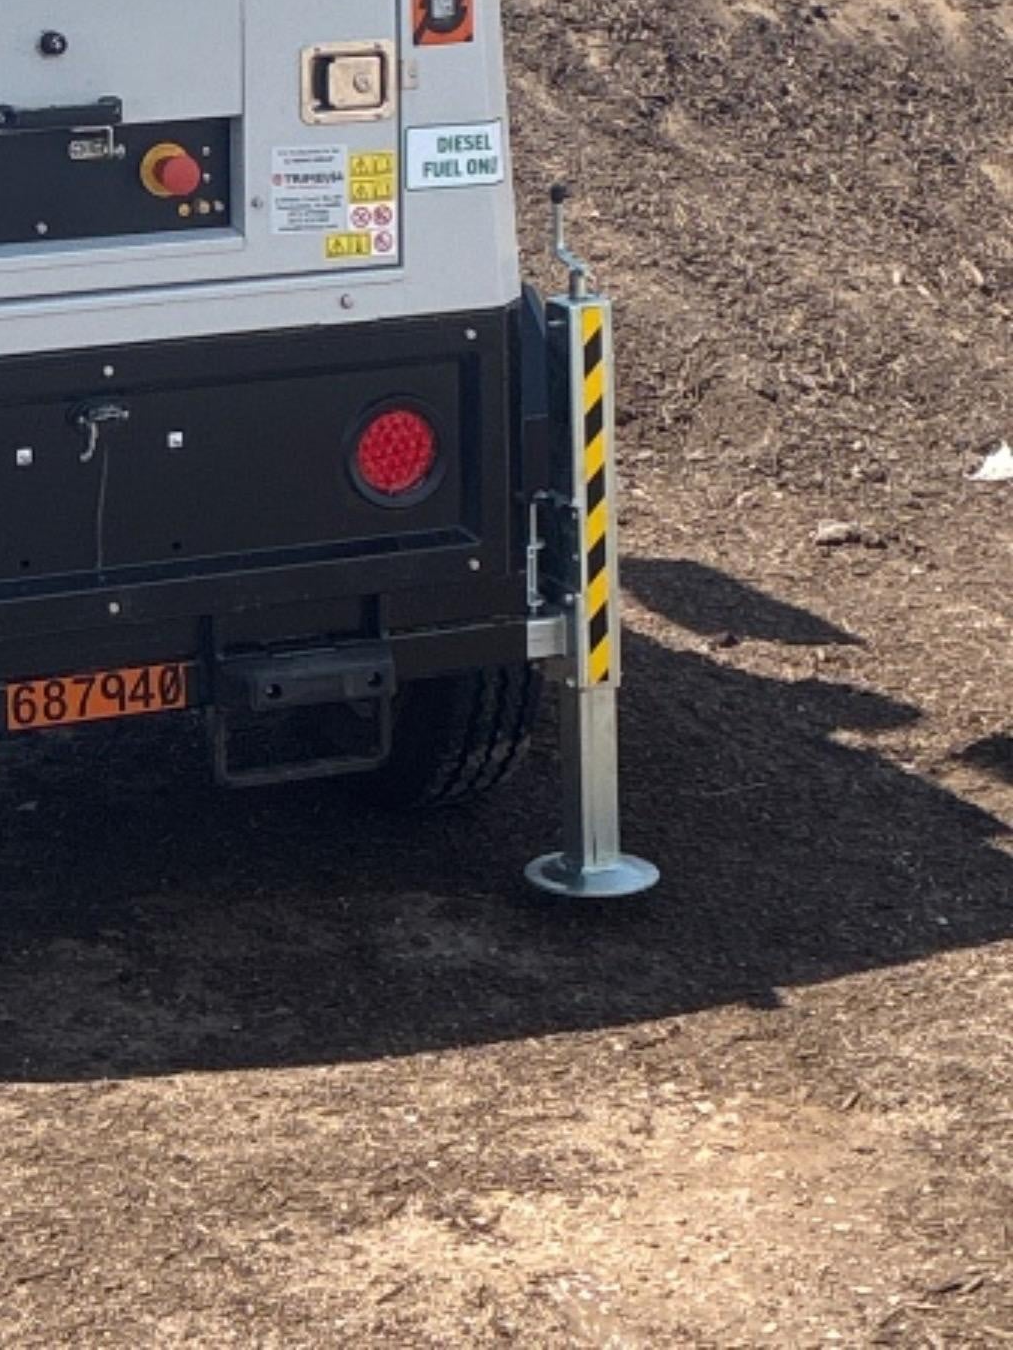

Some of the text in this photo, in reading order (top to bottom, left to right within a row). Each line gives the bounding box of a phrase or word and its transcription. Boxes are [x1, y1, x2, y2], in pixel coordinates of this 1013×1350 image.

[436, 134, 492, 153] DIESEL
[422, 158, 462, 178] FUEL
[12, 665, 182, 724] 687940
